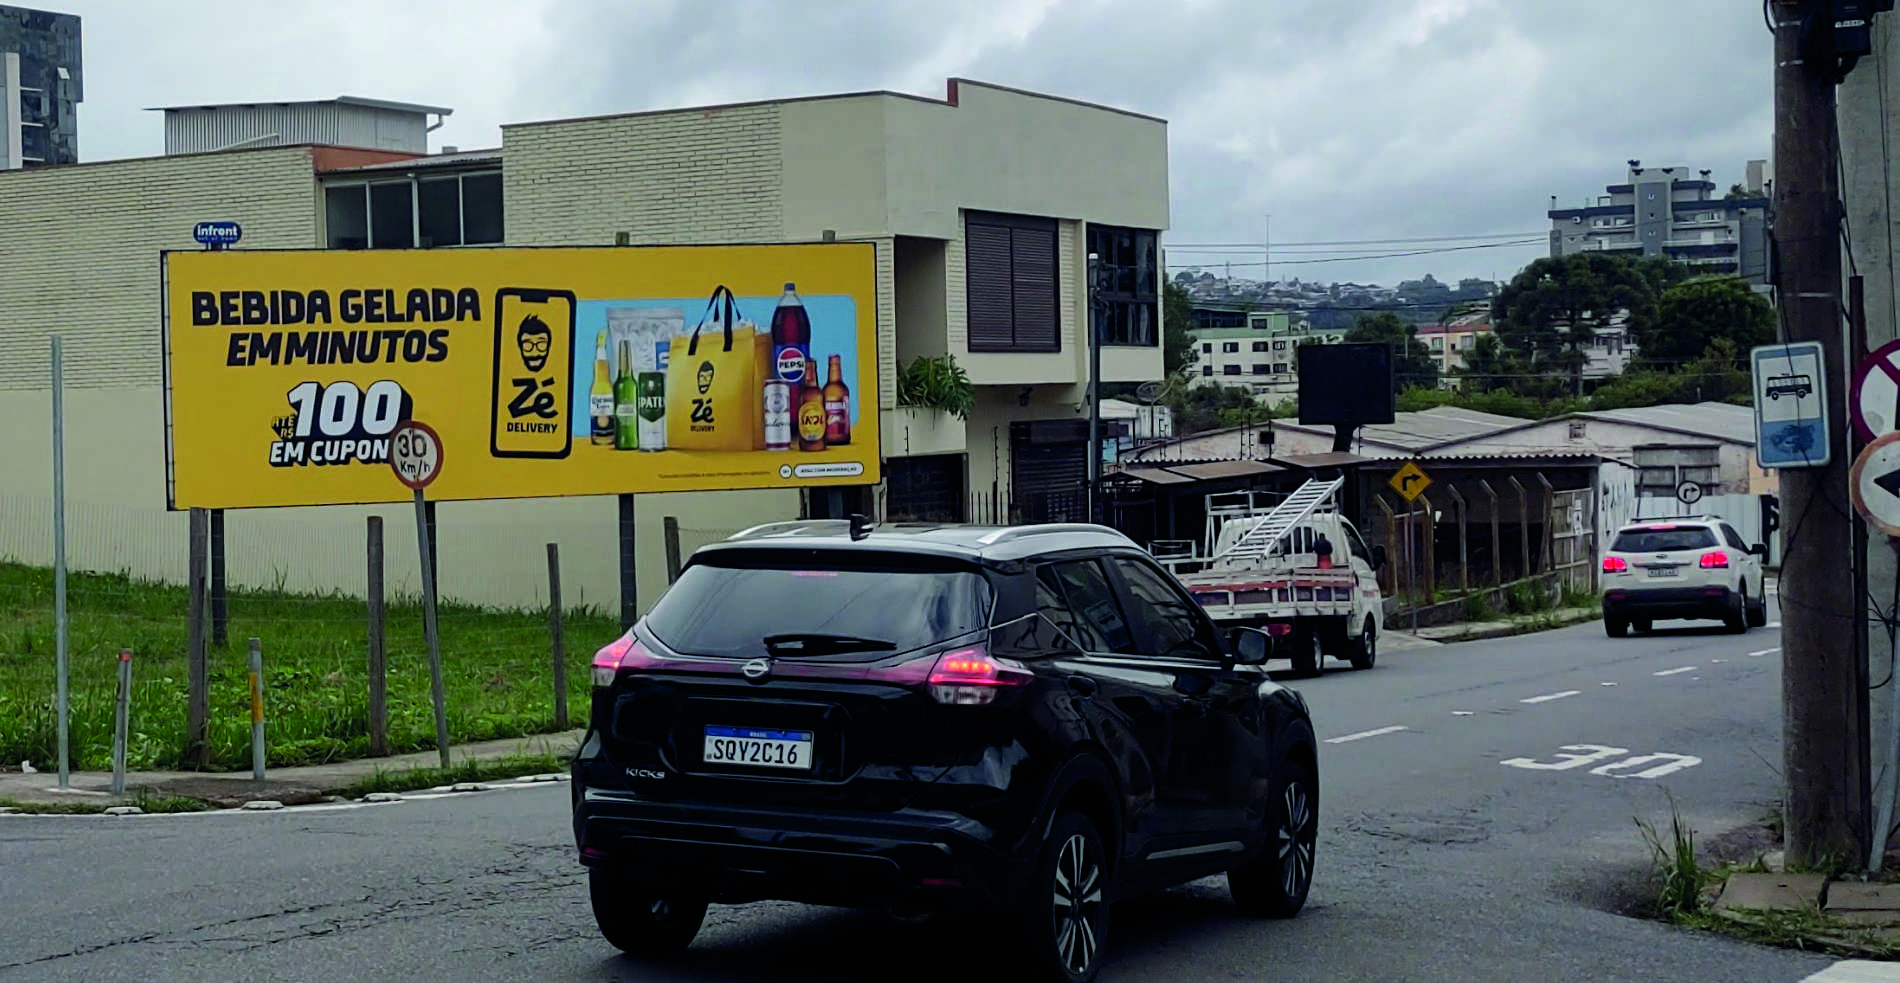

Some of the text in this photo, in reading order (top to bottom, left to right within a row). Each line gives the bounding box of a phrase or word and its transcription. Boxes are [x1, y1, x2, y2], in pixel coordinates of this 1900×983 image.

[192, 288, 481, 326] BEBIDA GELADA
[227, 329, 449, 366] EM MINUTOS
[779, 360, 805, 369] PEPSI
[288, 380, 408, 437] 100
[507, 377, 558, 419] Zé
[690, 398, 715, 423] Zé
[506, 422, 558, 434] DELIVERY
[269, 441, 306, 463] EM
[398, 434, 427, 458] 30
[400, 459, 431, 477] Km/h
[713, 738, 798, 765] SQY2C16
[1500, 744, 1702, 779] 30
[626, 768, 665, 779] KICKS
